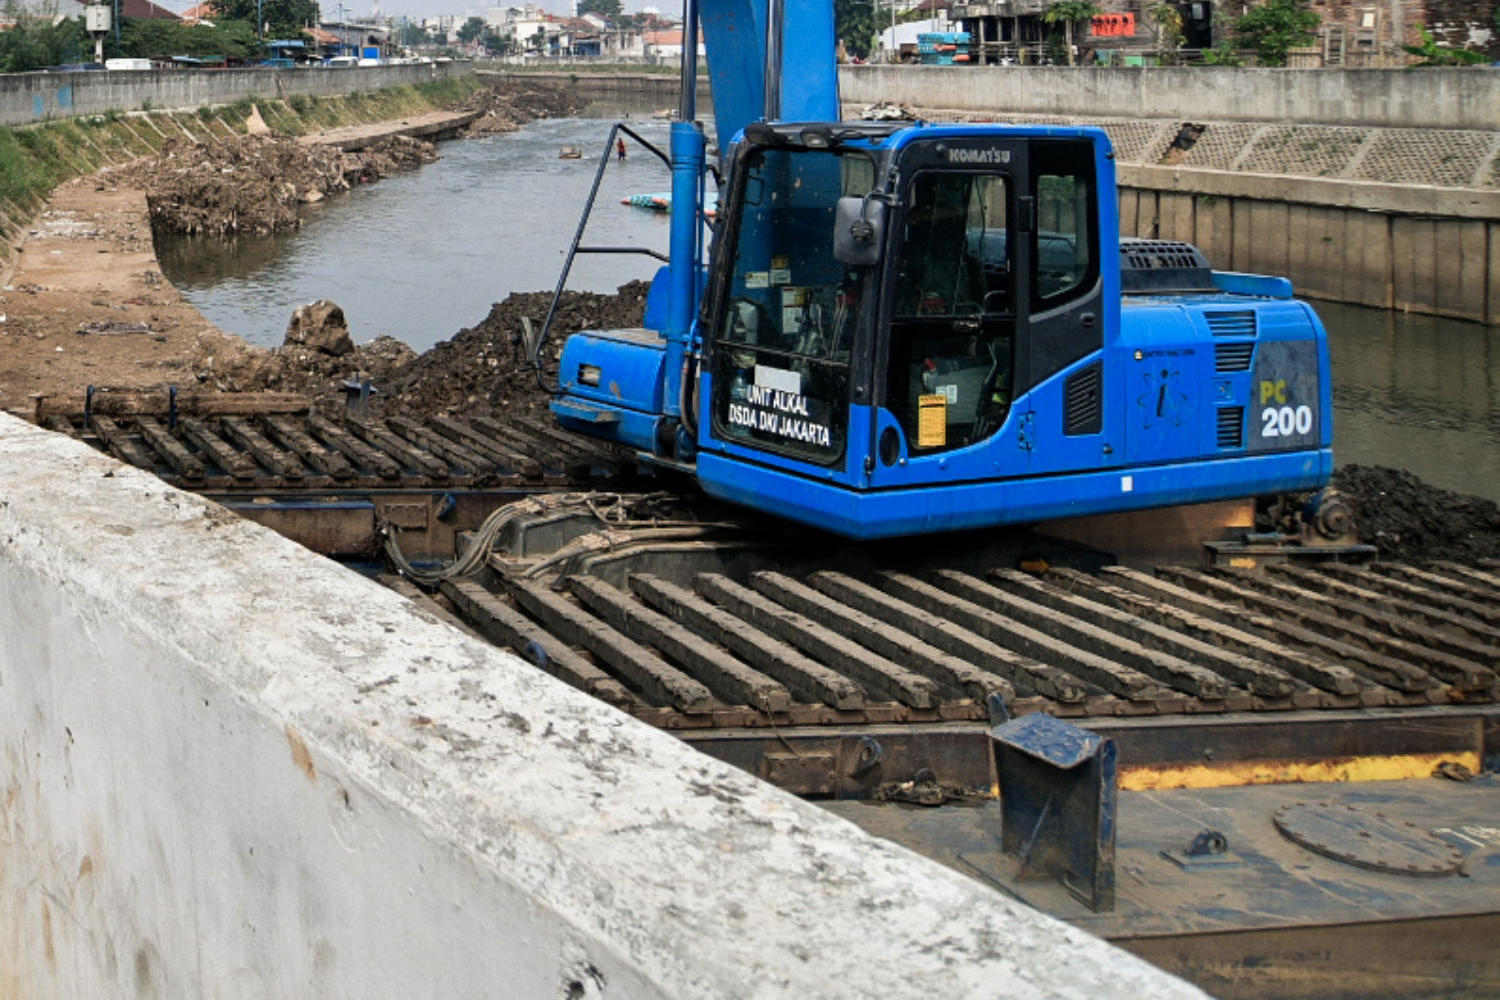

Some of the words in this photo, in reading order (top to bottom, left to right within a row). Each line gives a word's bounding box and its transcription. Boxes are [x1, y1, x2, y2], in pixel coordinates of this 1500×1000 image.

[948, 147, 1010, 163] KOMATSU
[746, 384, 772, 406] UNIT
[773, 391, 809, 416] ALKAL
[1260, 379, 1286, 404] PC
[728, 403, 757, 429] DSDA
[759, 411, 778, 433] DKI
[779, 416, 830, 447] JAKARTA
[1262, 405, 1312, 437] 200
